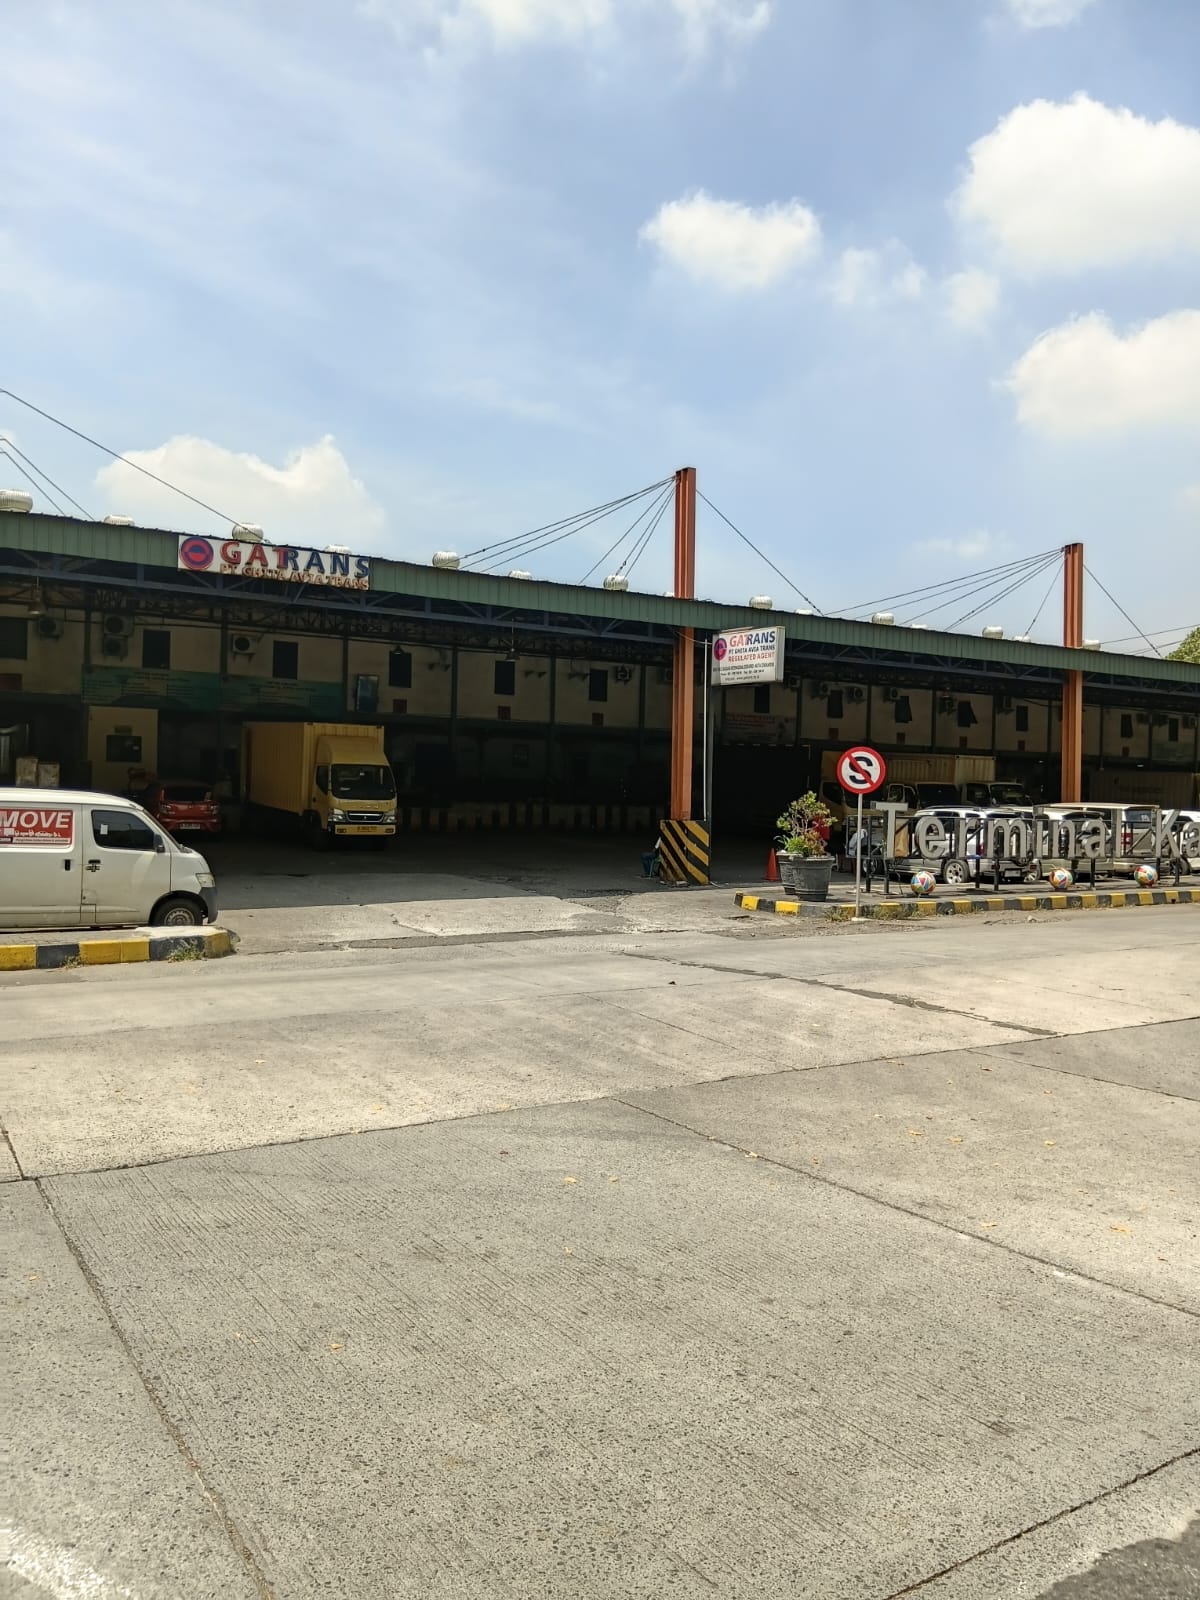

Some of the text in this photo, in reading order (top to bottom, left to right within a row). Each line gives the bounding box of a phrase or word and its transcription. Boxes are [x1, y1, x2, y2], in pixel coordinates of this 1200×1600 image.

[220, 541, 370, 578] GATRANS
[729, 631, 776, 647] GATRANS
[757, 652, 775, 660] AGENT
[849, 756, 873, 784] S
[0, 810, 71, 829] MOVE
[871, 801, 1123, 860] Terminal
